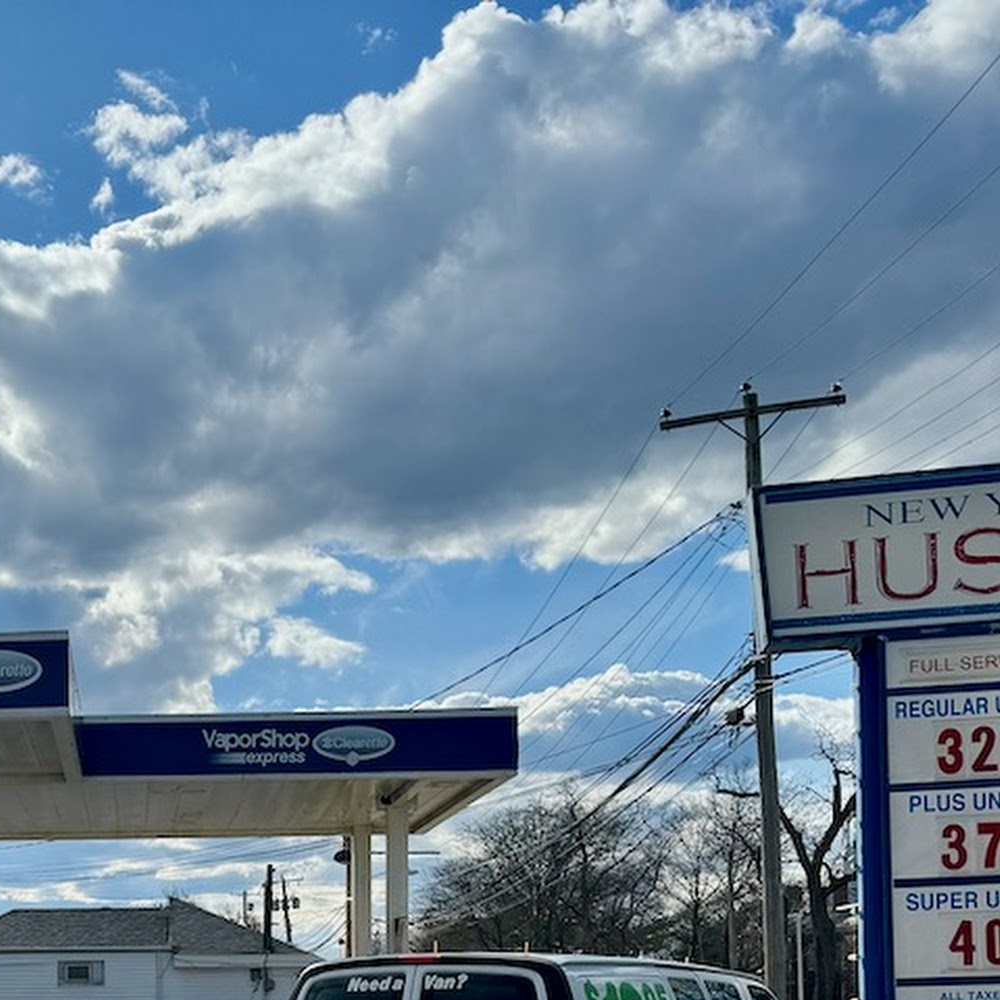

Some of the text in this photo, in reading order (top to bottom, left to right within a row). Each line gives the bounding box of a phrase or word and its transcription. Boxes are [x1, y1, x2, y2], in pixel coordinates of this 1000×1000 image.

[866, 494, 969, 527] NEW
[794, 527, 1000, 609] HUS
[909, 654, 1000, 674] FULL SER
[895, 697, 988, 719] REGULAR
[202, 728, 310, 752] VaporShop
[937, 725, 999, 775] 32
[246, 751, 306, 767] express
[909, 793, 966, 813] PLUS
[941, 822, 1000, 870] 37
[906, 891, 978, 912] SUPER
[347, 974, 469, 992] Need a Van?
